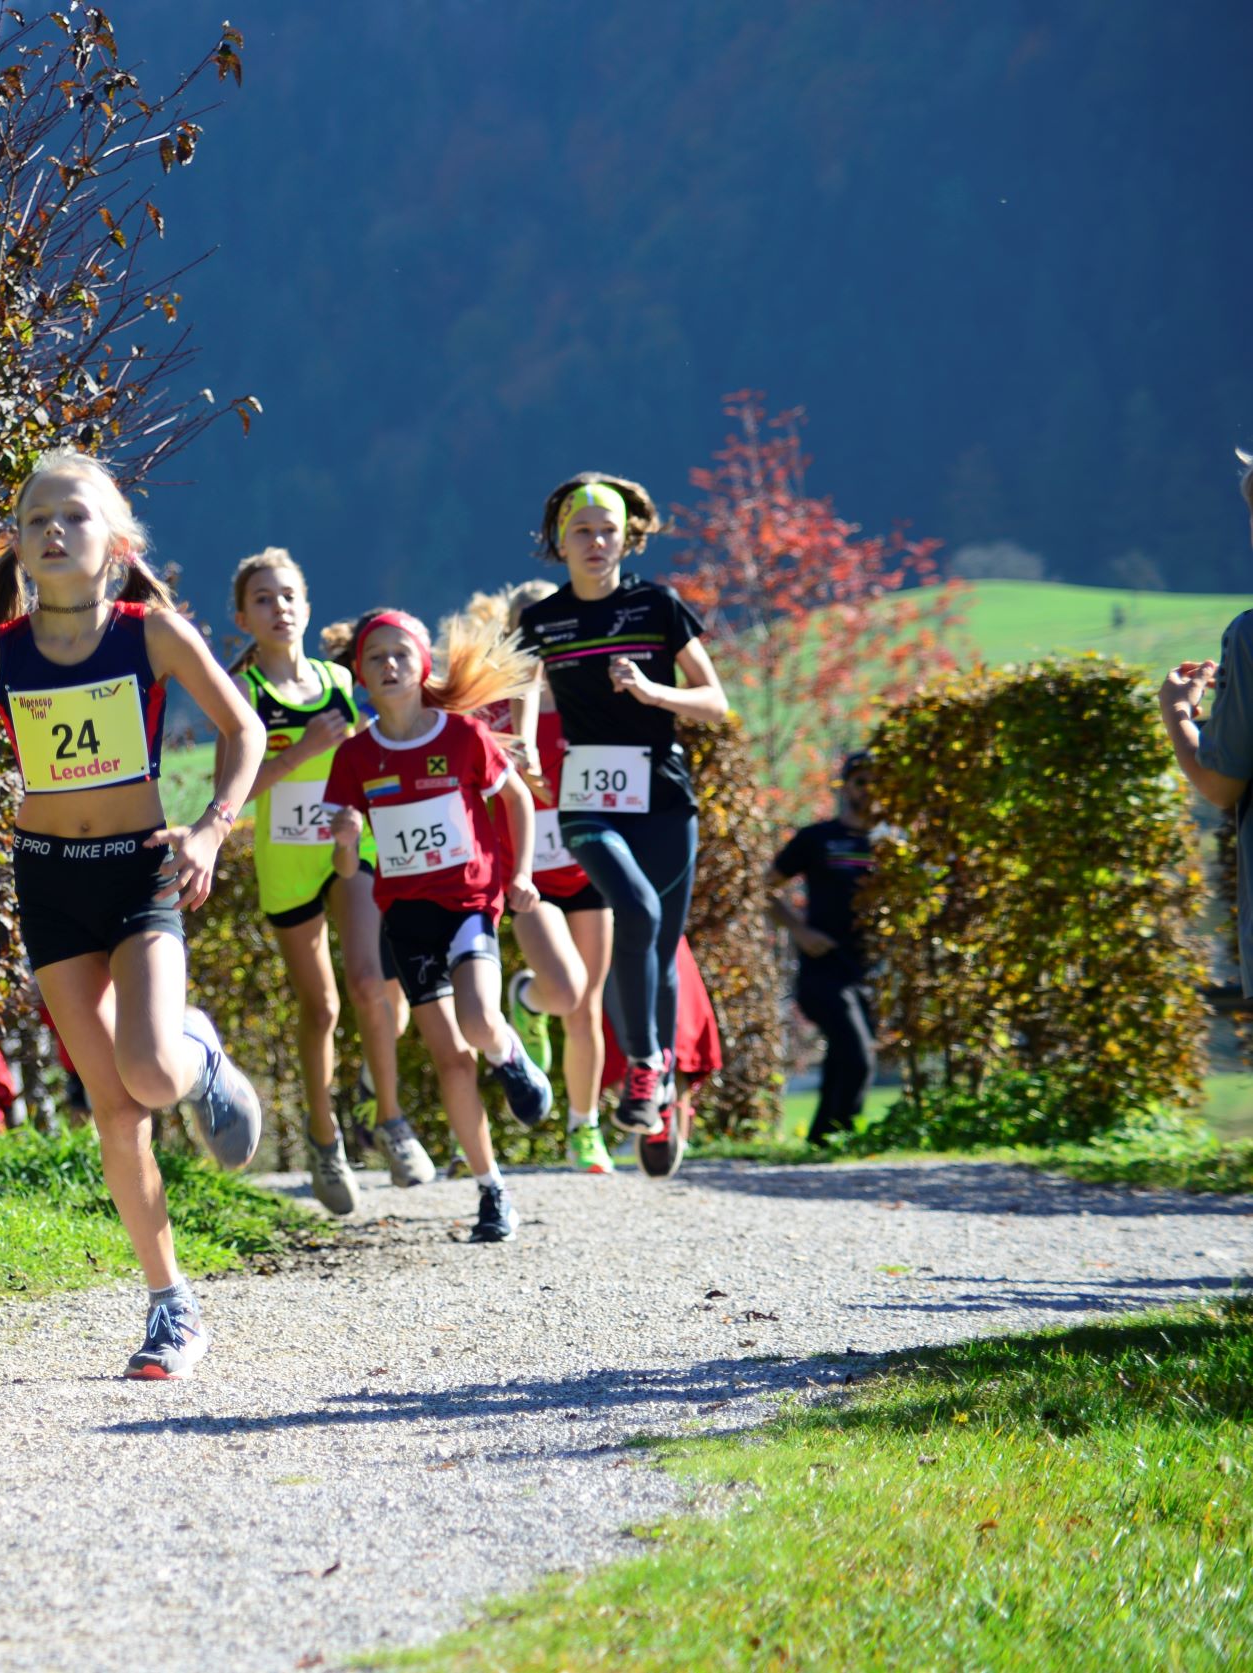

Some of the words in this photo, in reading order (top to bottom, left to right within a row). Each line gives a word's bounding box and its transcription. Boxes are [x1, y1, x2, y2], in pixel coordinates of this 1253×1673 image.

[51, 718, 101, 760] 24
[49, 758, 121, 782] Leader
[580, 769, 628, 792] 130
[293, 804, 334, 826] 12
[21, 838, 51, 855] PRO
[63, 844, 101, 858] NIKE
[104, 840, 136, 856] PRO
[395, 823, 447, 853] 125
